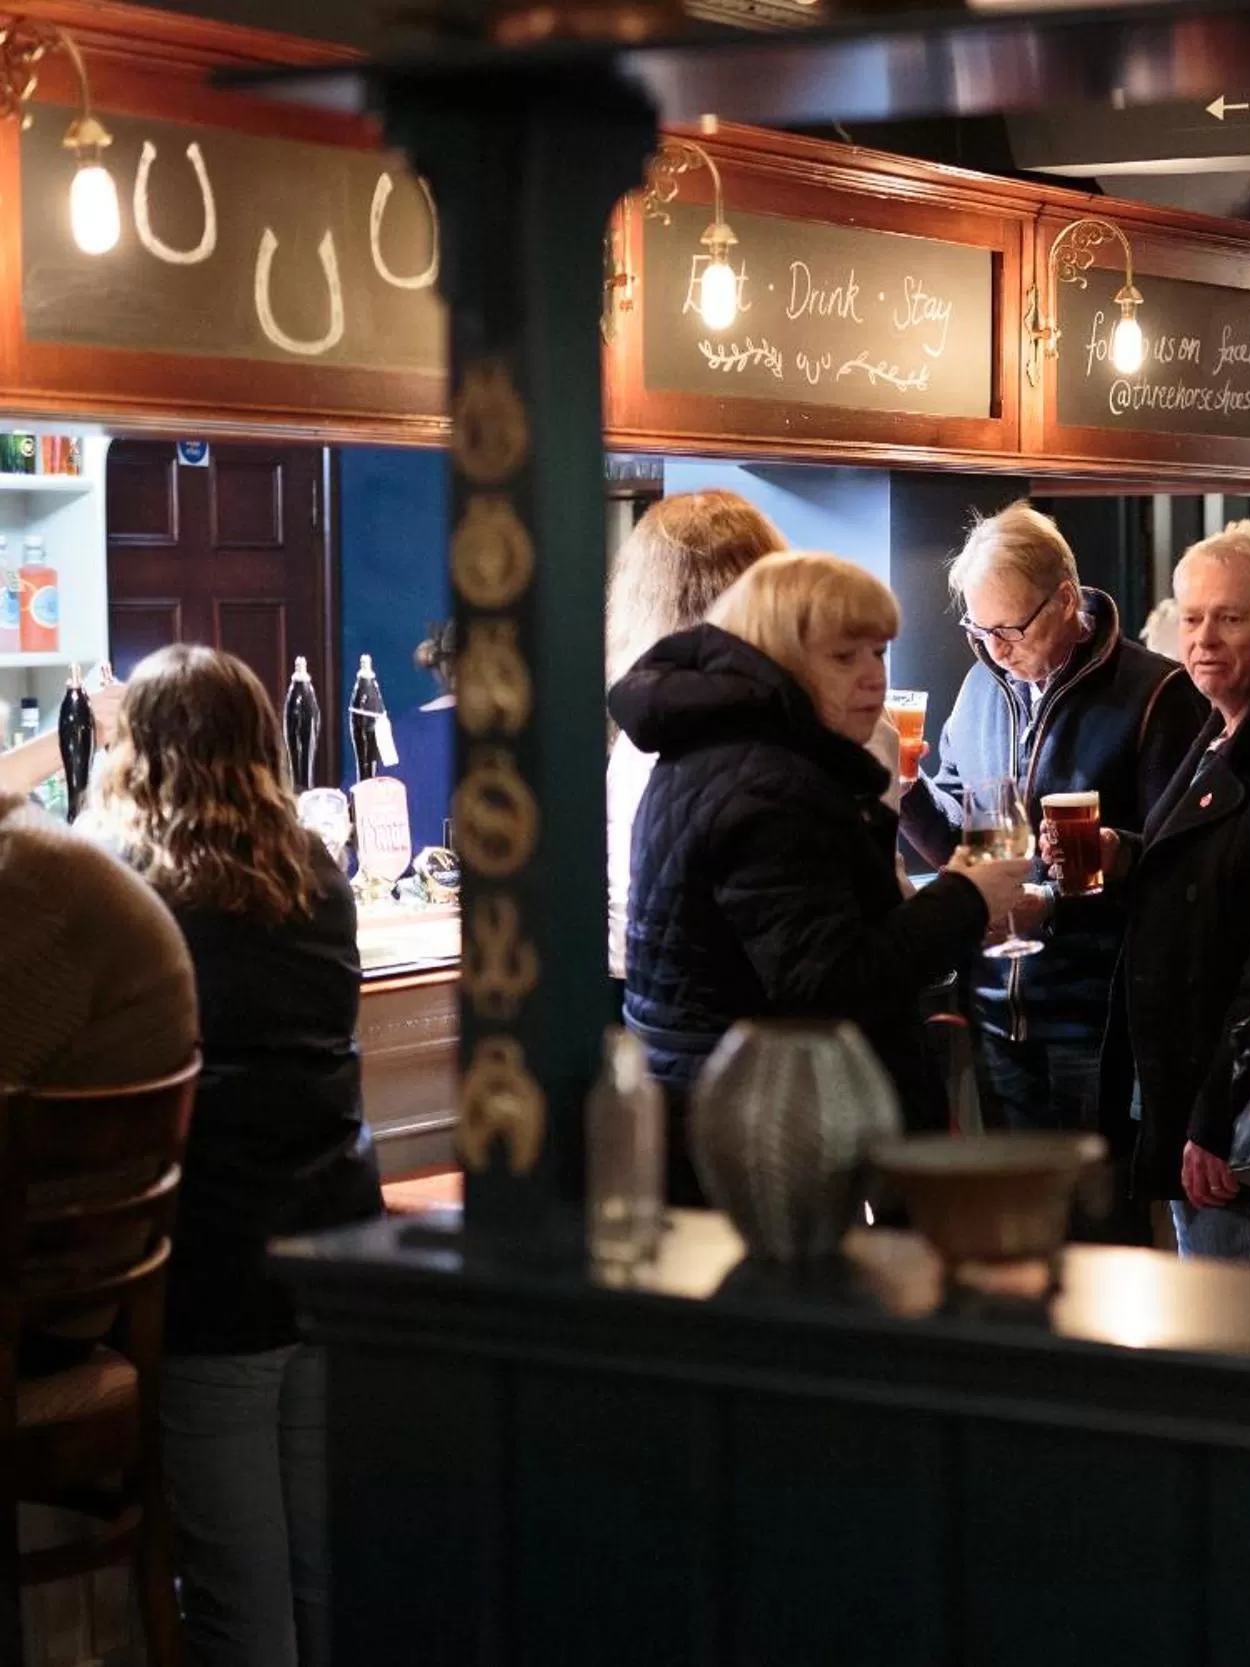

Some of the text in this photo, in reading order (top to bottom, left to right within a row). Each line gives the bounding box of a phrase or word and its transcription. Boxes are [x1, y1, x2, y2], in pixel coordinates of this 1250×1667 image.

[682, 255, 952, 358] Et Drink Stay
